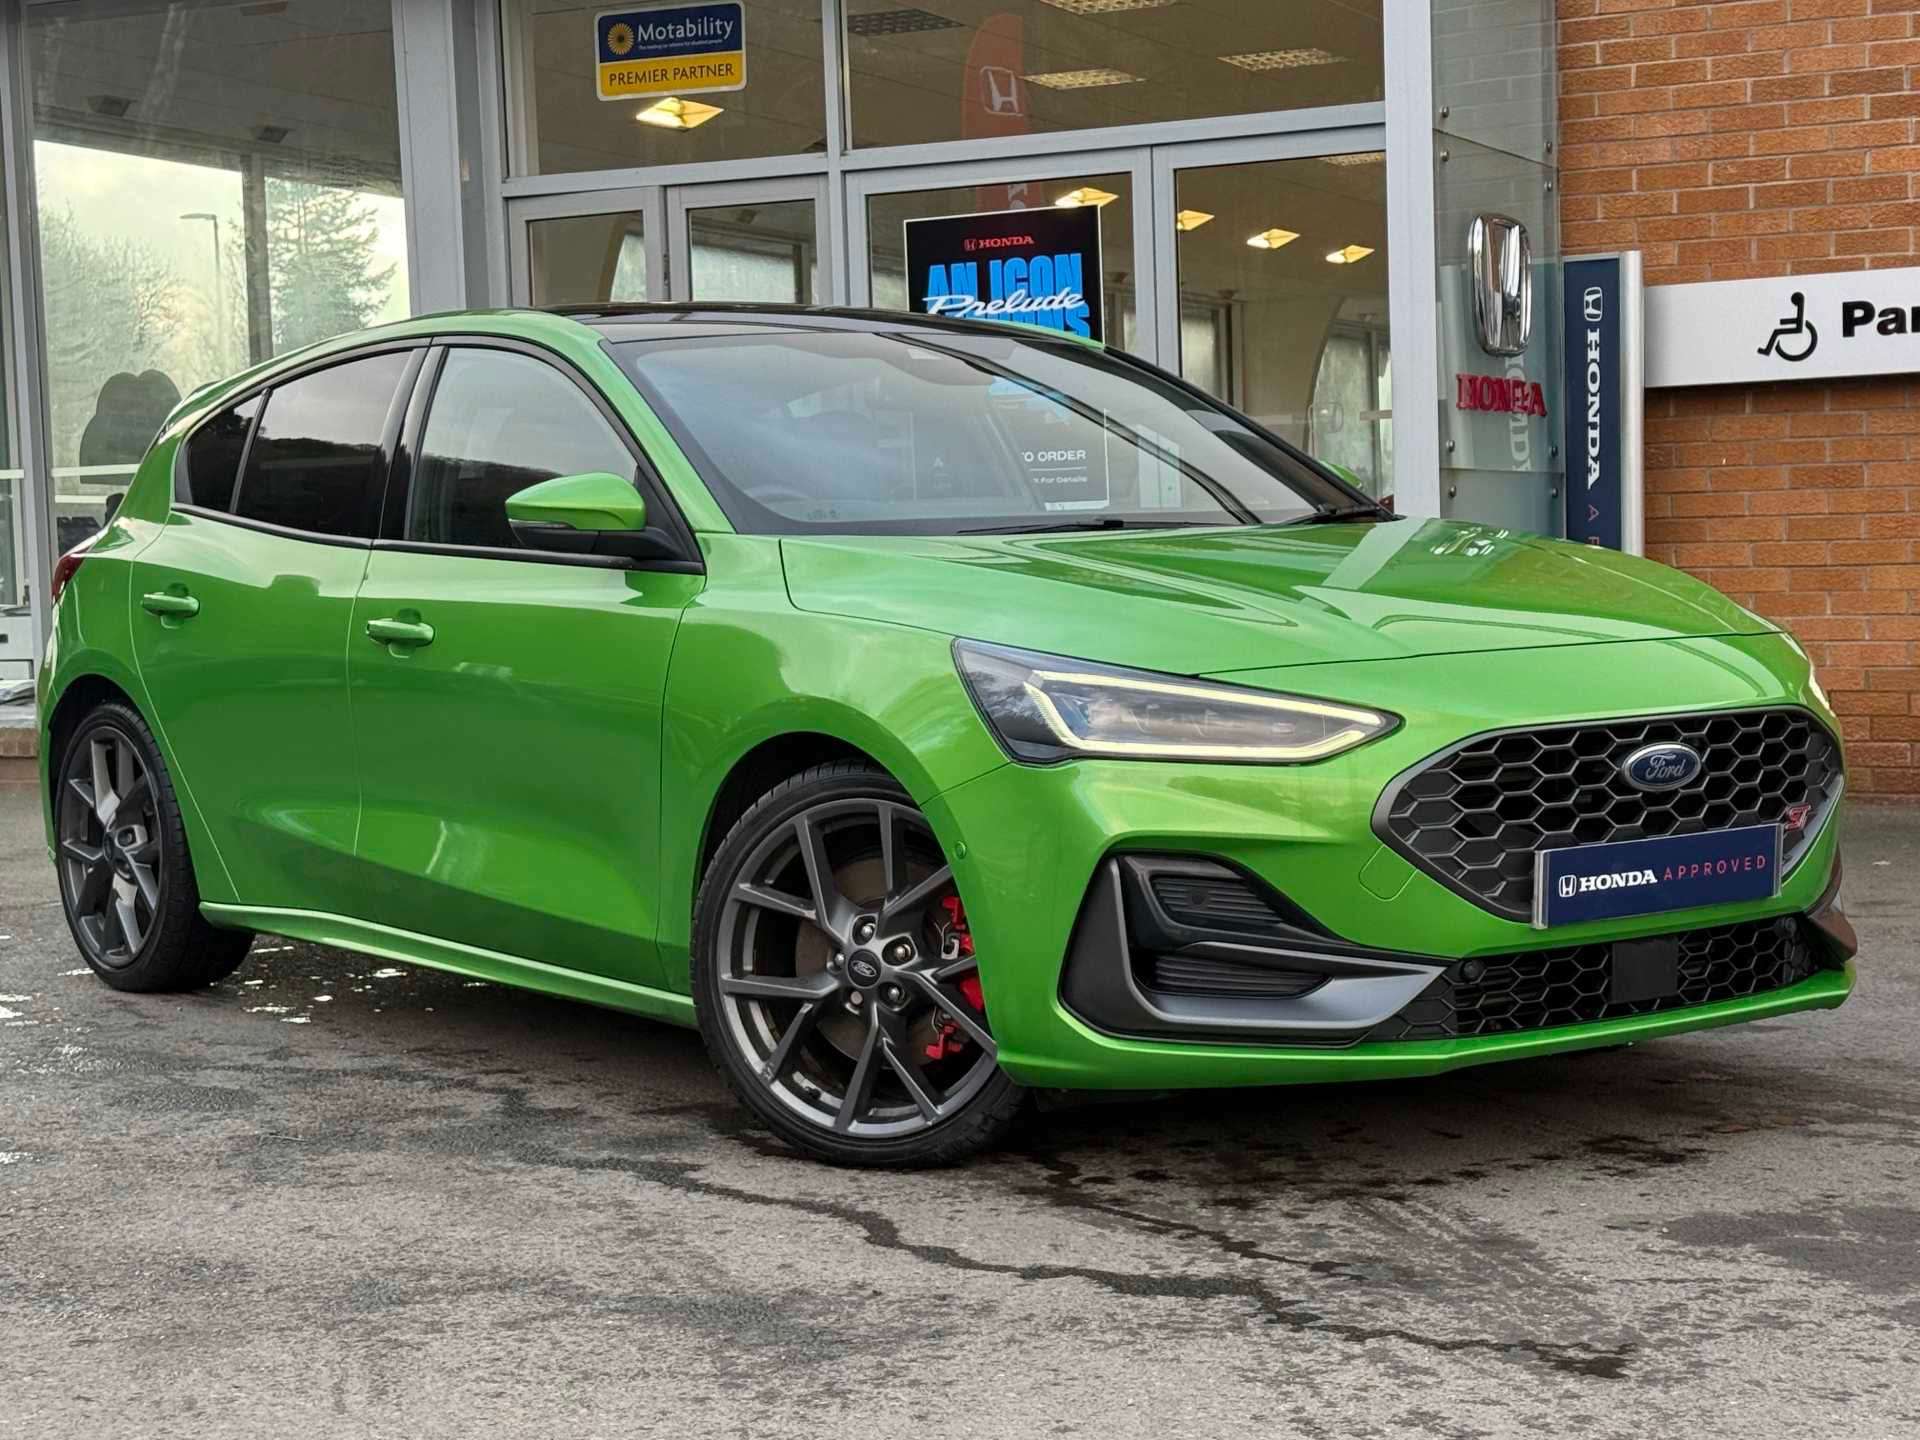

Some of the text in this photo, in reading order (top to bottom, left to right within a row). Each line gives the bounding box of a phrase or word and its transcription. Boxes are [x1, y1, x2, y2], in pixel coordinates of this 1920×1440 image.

[637, 15, 734, 42] Motability
[608, 63, 735, 87] PREMIER PARTNER
[978, 235, 1035, 249] HONDA
[927, 253, 1083, 313] AN ICON
[922, 286, 1086, 318] Prelude
[1455, 373, 1548, 417] HONDA
[1586, 328, 1601, 490] HONDA
[1022, 449, 1087, 462] O ORDER
[1645, 753, 1687, 779] Ford
[1784, 804, 1811, 831] ST
[1578, 854, 1767, 893] HONDA APPROVED
